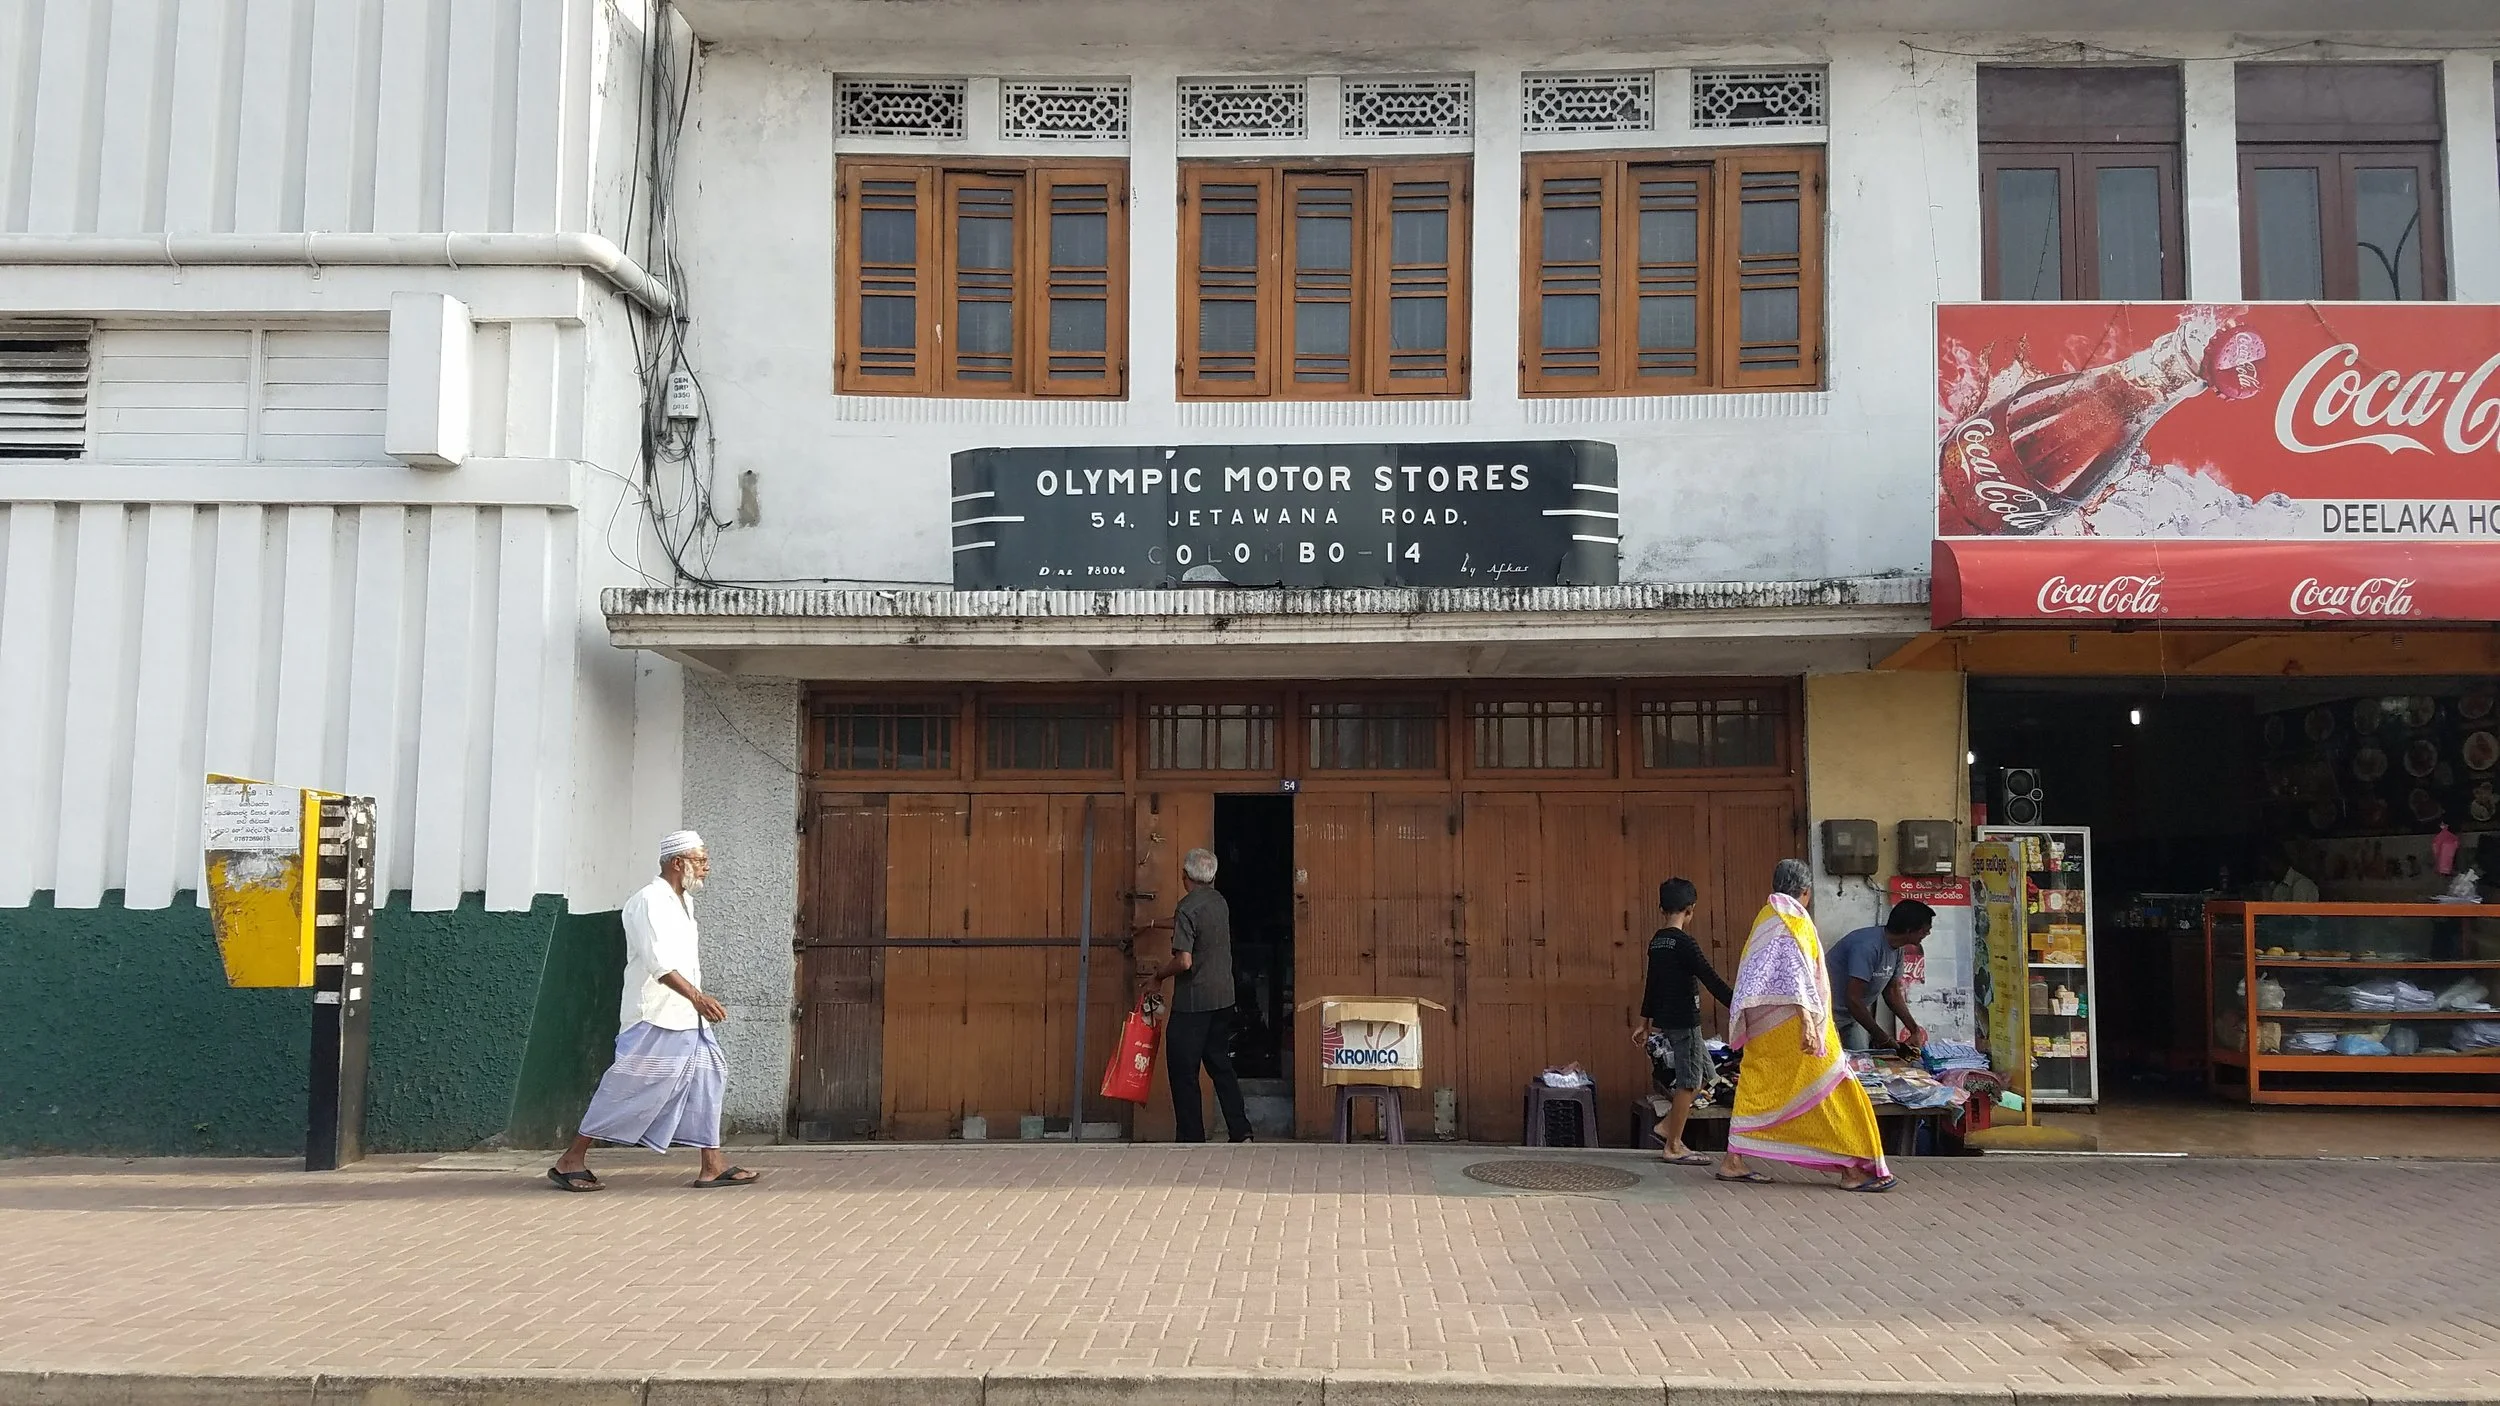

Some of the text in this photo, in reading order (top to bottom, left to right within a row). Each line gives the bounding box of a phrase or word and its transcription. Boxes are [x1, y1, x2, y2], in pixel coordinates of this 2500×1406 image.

[2275, 342, 2500, 455] Coca-C
[1036, 464, 1529, 496] OLYMPIC MOTOR STORES
[1957, 418, 2062, 529] Coca-Cola
[1168, 508, 1338, 527] JETAWANA
[2323, 504, 2459, 533] DEELAKA
[1087, 566, 1126, 575] 78004
[1461, 553, 1476, 577] by
[2037, 575, 2165, 614] Coca-Cola
[2290, 577, 2416, 615] Coca-Cola
[1284, 781, 1295, 790] 54
[1335, 1049, 1398, 1064] KROMCO
